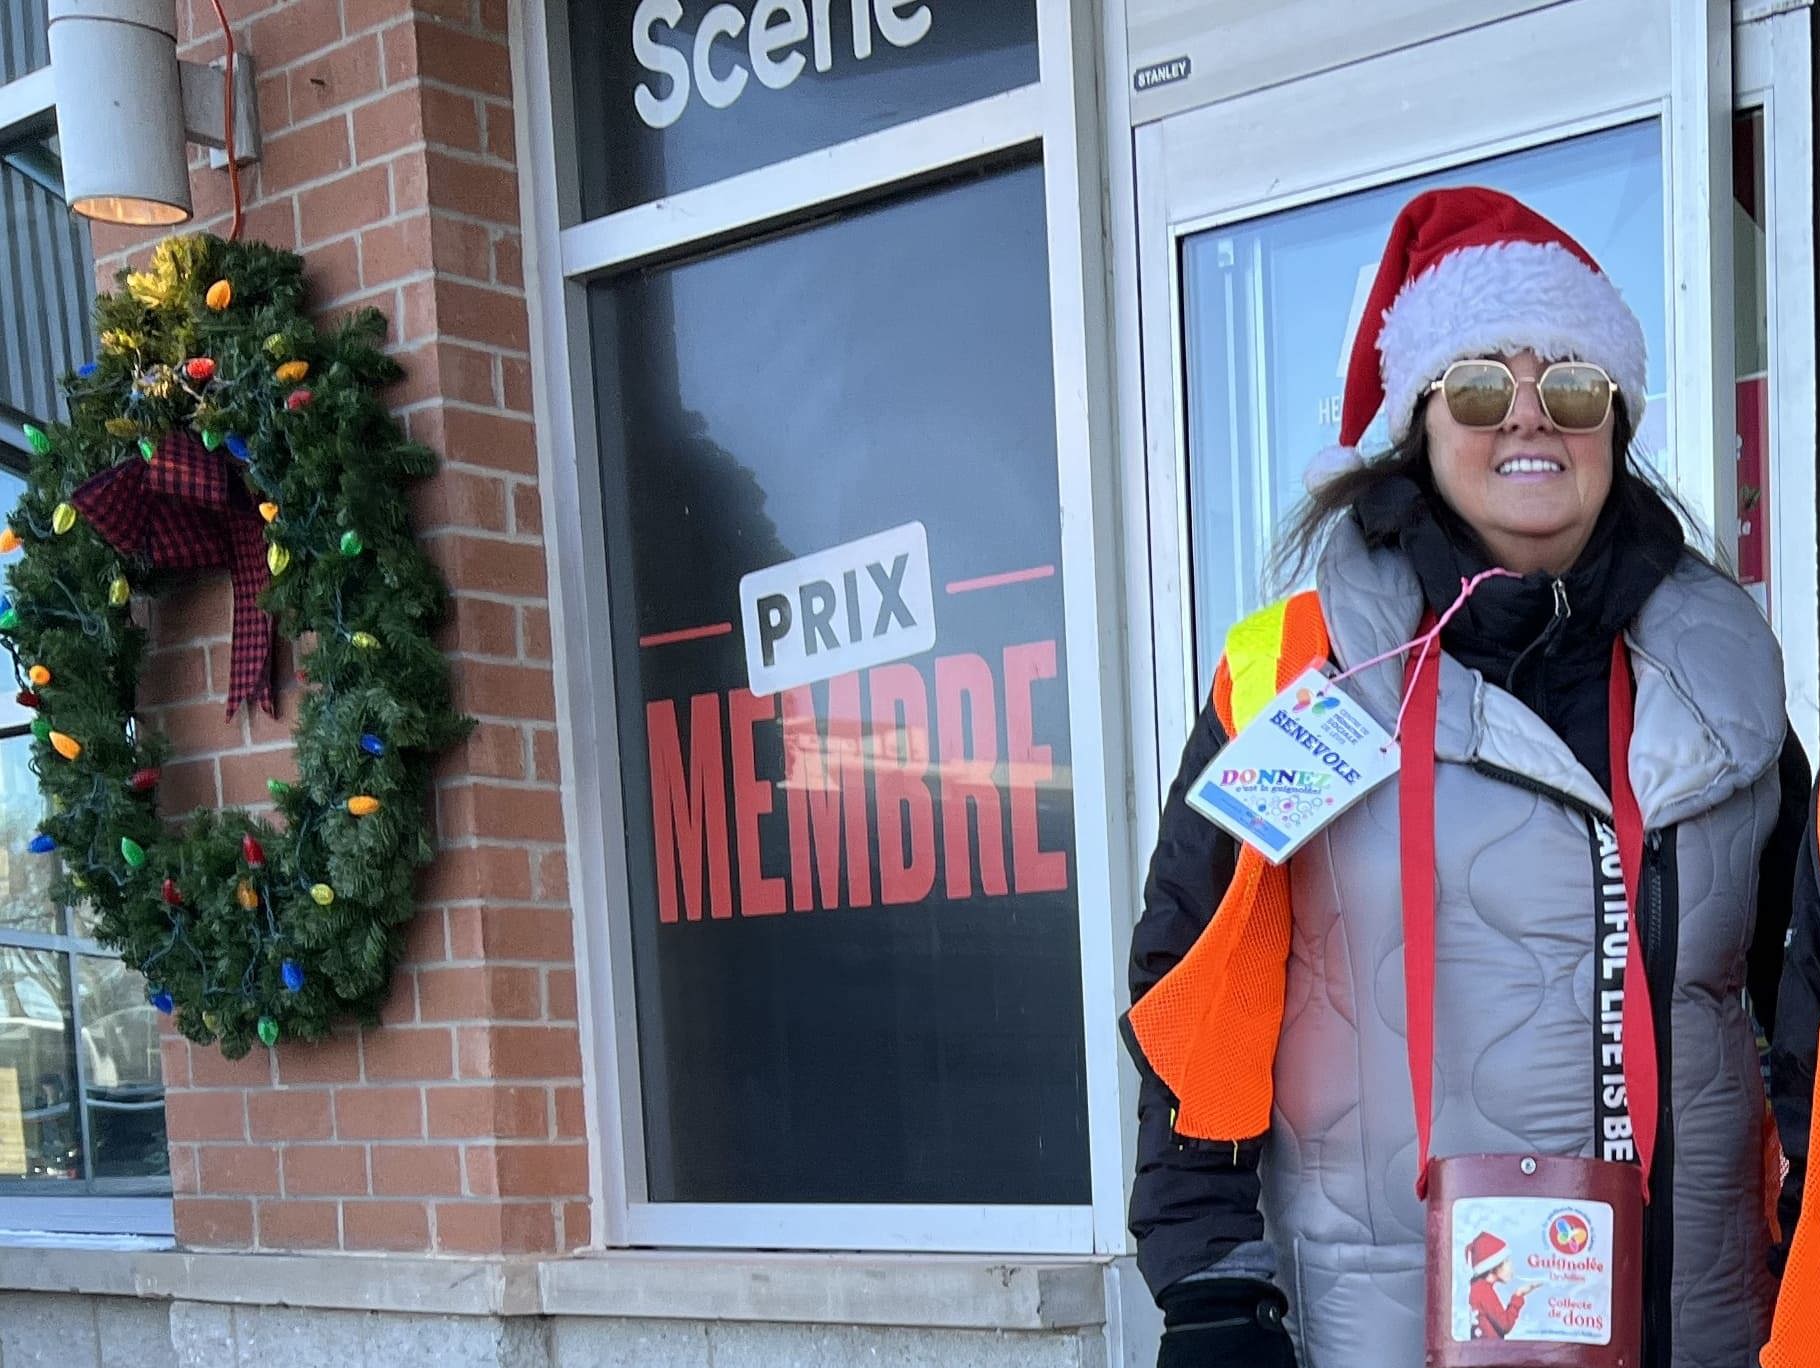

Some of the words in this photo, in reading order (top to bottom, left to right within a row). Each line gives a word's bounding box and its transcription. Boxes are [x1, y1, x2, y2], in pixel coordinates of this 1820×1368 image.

[1137, 59, 1187, 89] STANLEY
[756, 552, 917, 668] PRIX
[1269, 709, 1361, 787] BÉNÉVOLE
[646, 640, 1069, 924] MEMBRE
[1220, 768, 1333, 790] DONNEZ
[1601, 1074, 1629, 1109] IS
[1548, 1297, 1593, 1310] Collecte
[1548, 1309, 1561, 1319] de
[1563, 1310, 1604, 1329] dons
